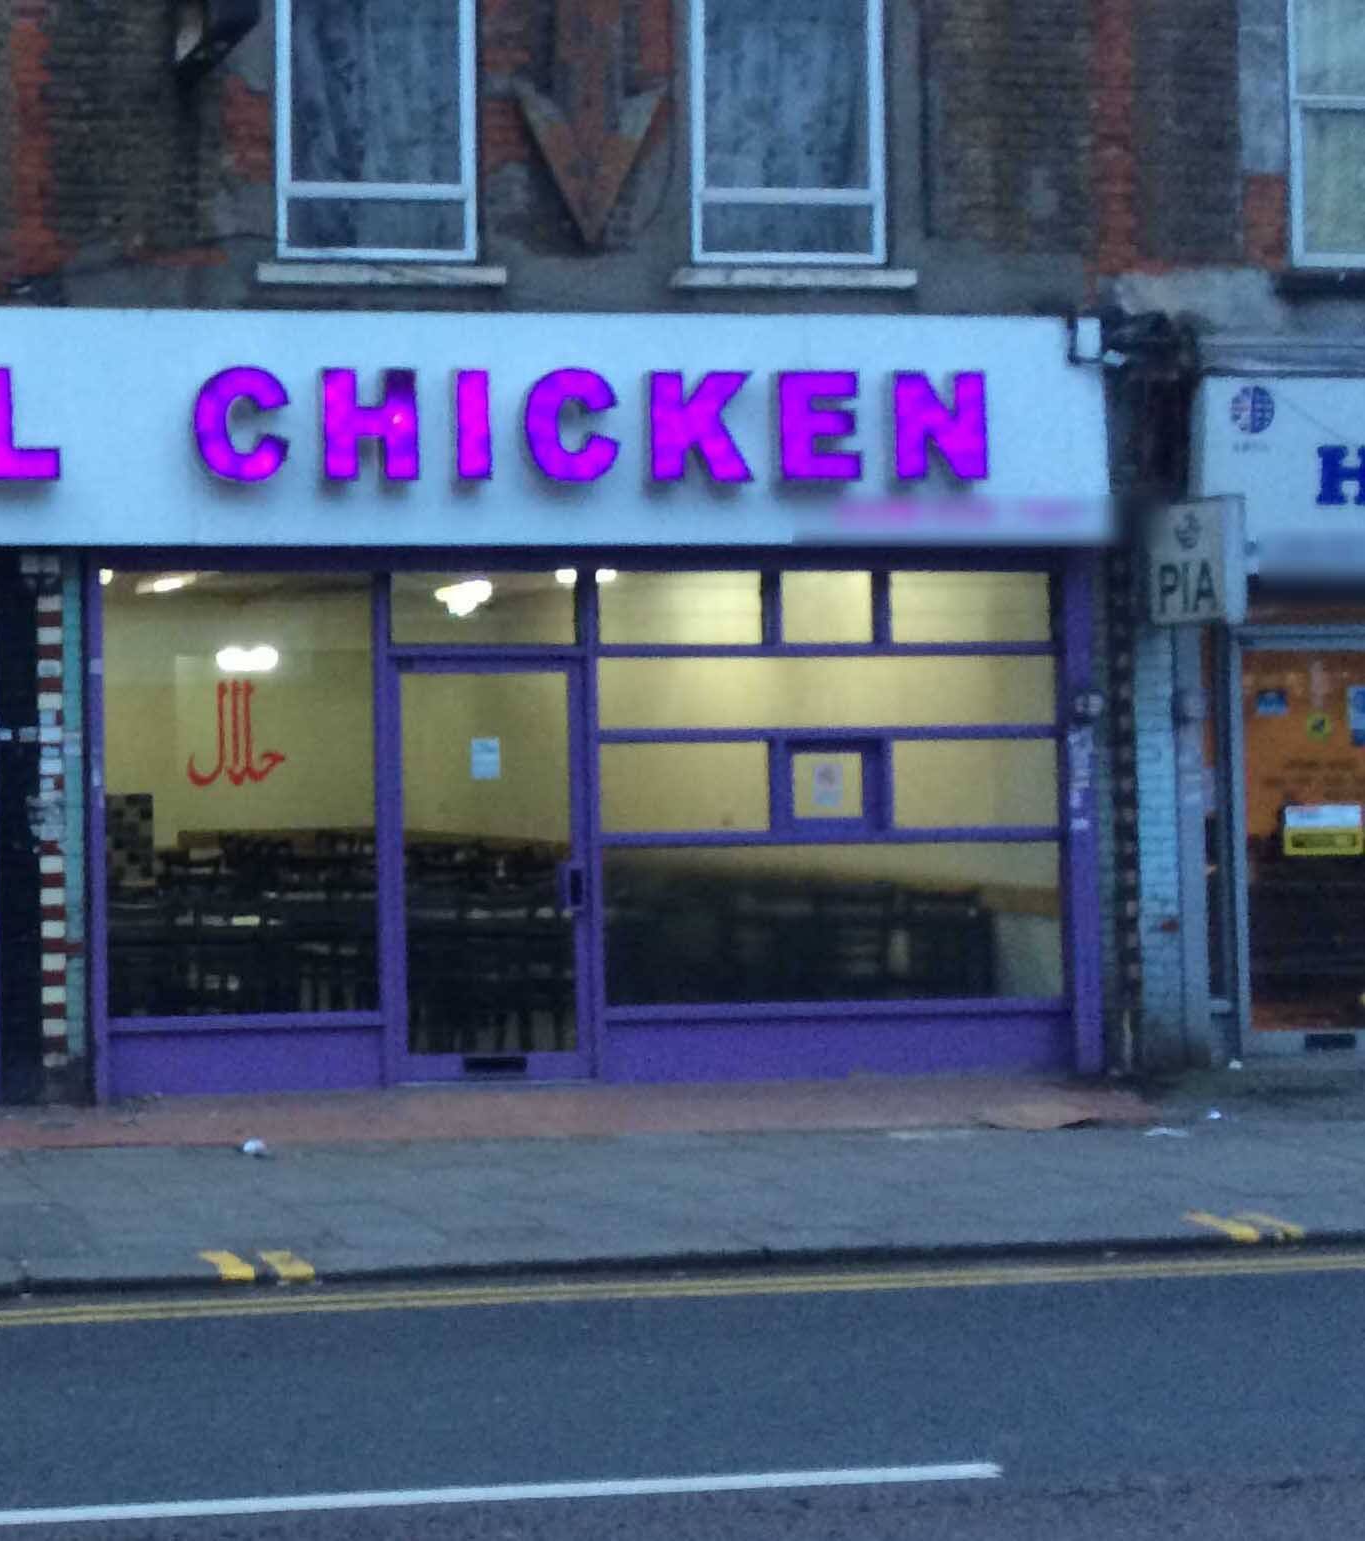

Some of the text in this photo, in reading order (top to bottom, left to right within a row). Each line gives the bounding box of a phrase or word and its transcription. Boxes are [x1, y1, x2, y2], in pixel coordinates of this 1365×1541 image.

[194, 367, 988, 483] CHICKEN
[1159, 560, 1218, 613] PIA
[186, 679, 285, 786] حلال
